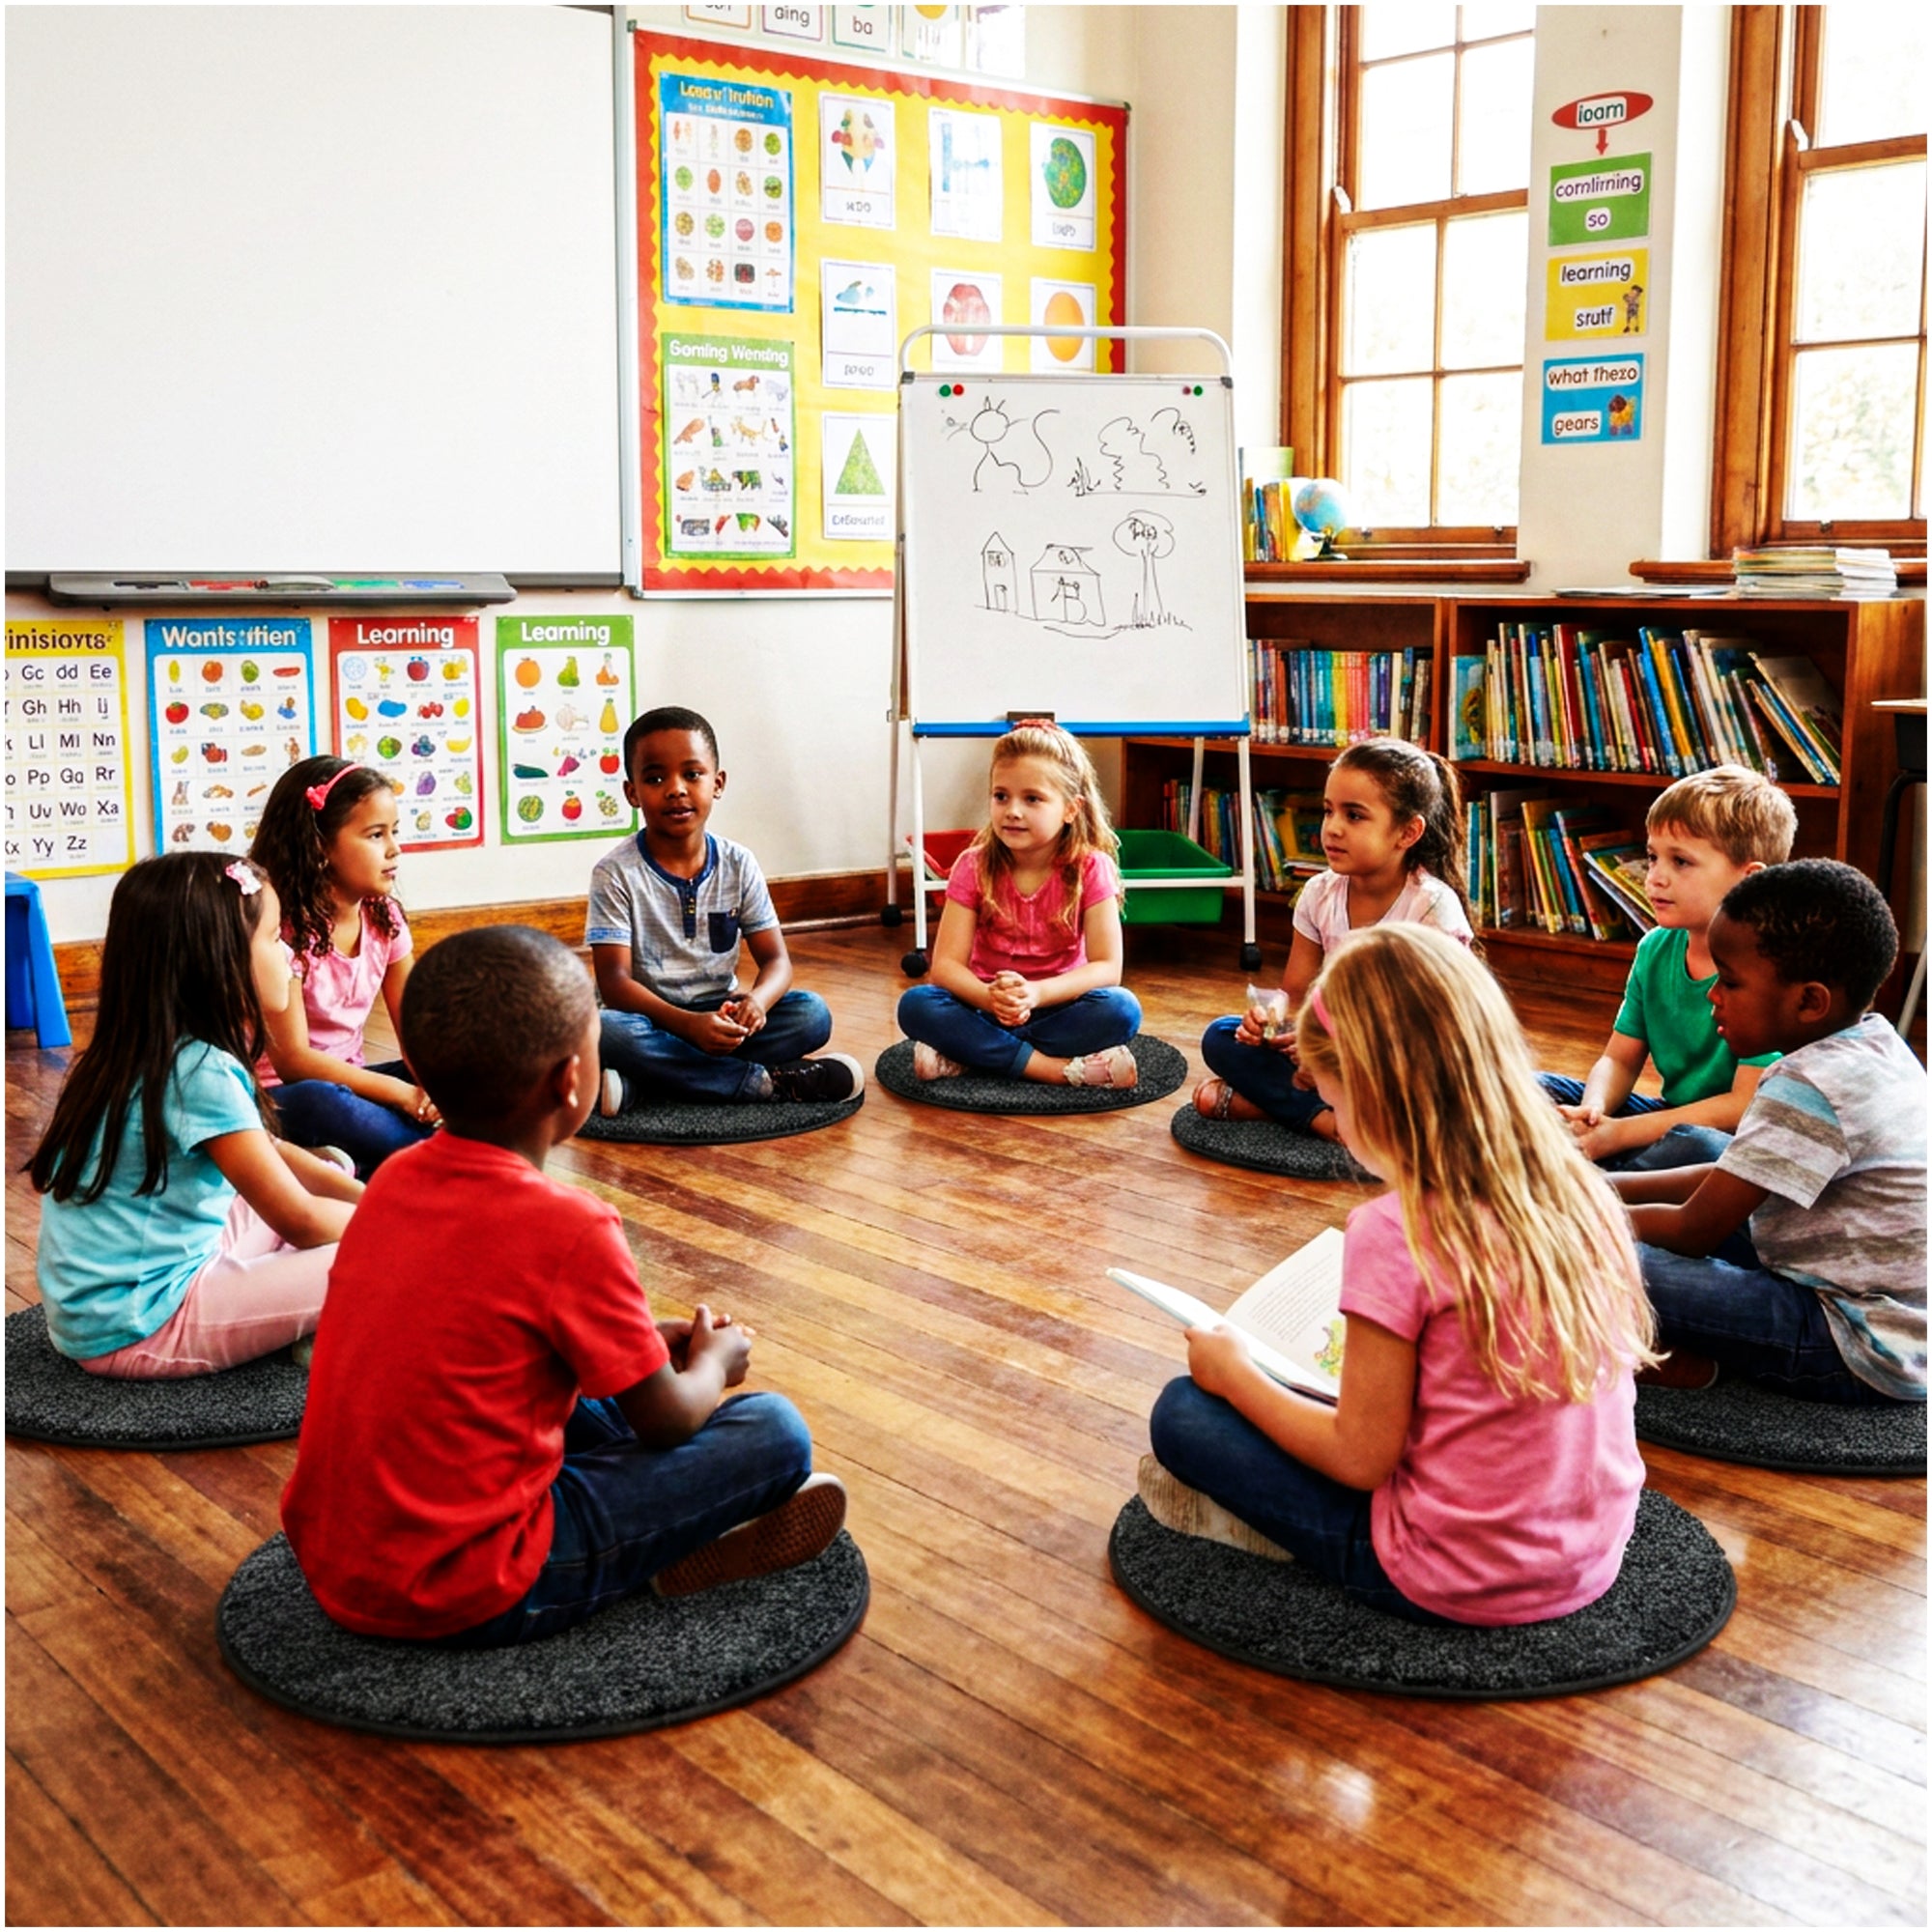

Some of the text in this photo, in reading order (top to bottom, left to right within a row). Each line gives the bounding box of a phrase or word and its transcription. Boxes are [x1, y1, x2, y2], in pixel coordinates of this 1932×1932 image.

[1588, 213, 1607, 227] so
[1561, 262, 1631, 282] learning
[1548, 369, 1589, 385] what
[1554, 417, 1599, 436] gears
[161, 626, 236, 647] Wants
[356, 622, 454, 648] Learning
[56, 665, 78, 679] dd
[90, 664, 112, 679] Ee
[22, 699, 46, 715] Gh
[58, 698, 81, 714] Hh
[94, 732, 116, 747] Nn
[27, 769, 50, 784] Pp
[96, 766, 116, 781] Rr
[97, 800, 119, 815] Xa
[32, 838, 54, 858] Yy
[67, 836, 87, 851] Zz
